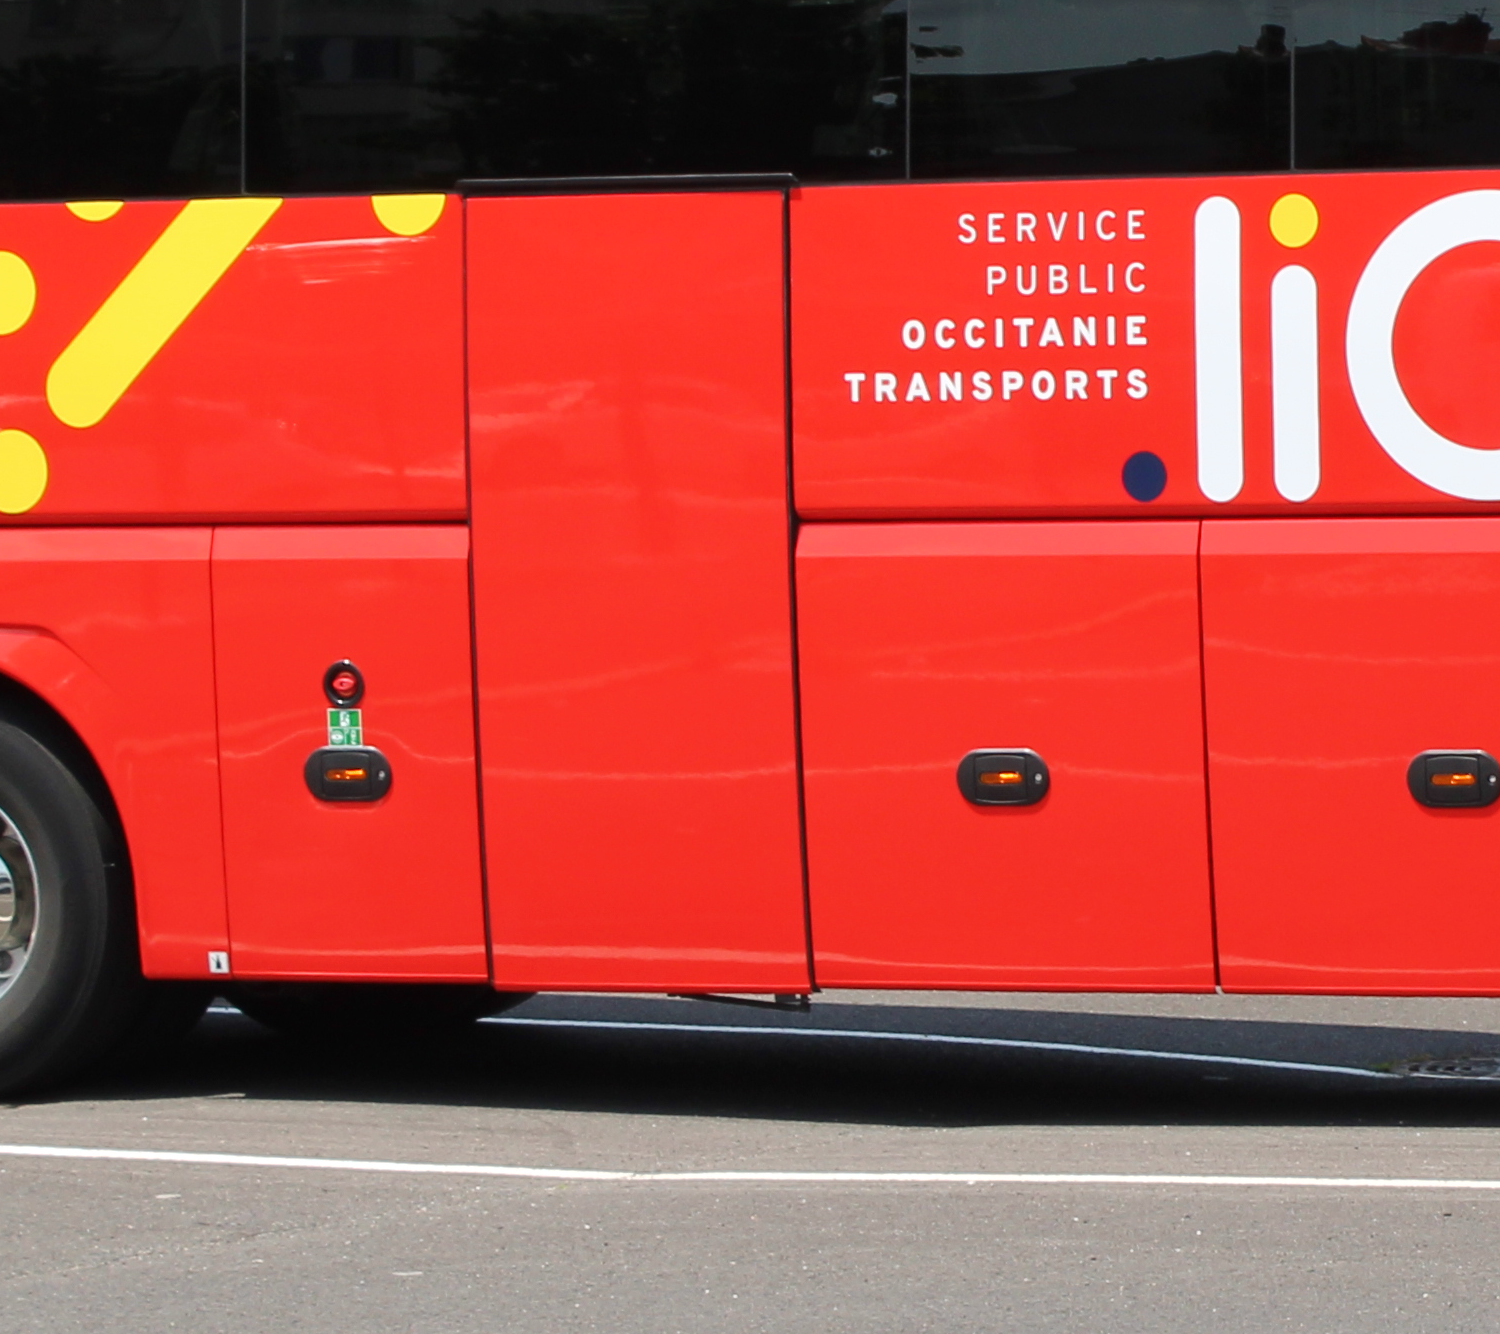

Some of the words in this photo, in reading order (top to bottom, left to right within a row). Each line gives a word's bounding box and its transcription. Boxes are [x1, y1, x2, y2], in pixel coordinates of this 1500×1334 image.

[958, 210, 1146, 244] SERVICE
[987, 263, 1146, 295] PUBLIC
[902, 316, 1147, 350] OCCITANIE
[844, 369, 1148, 403] TRANSPORTS
